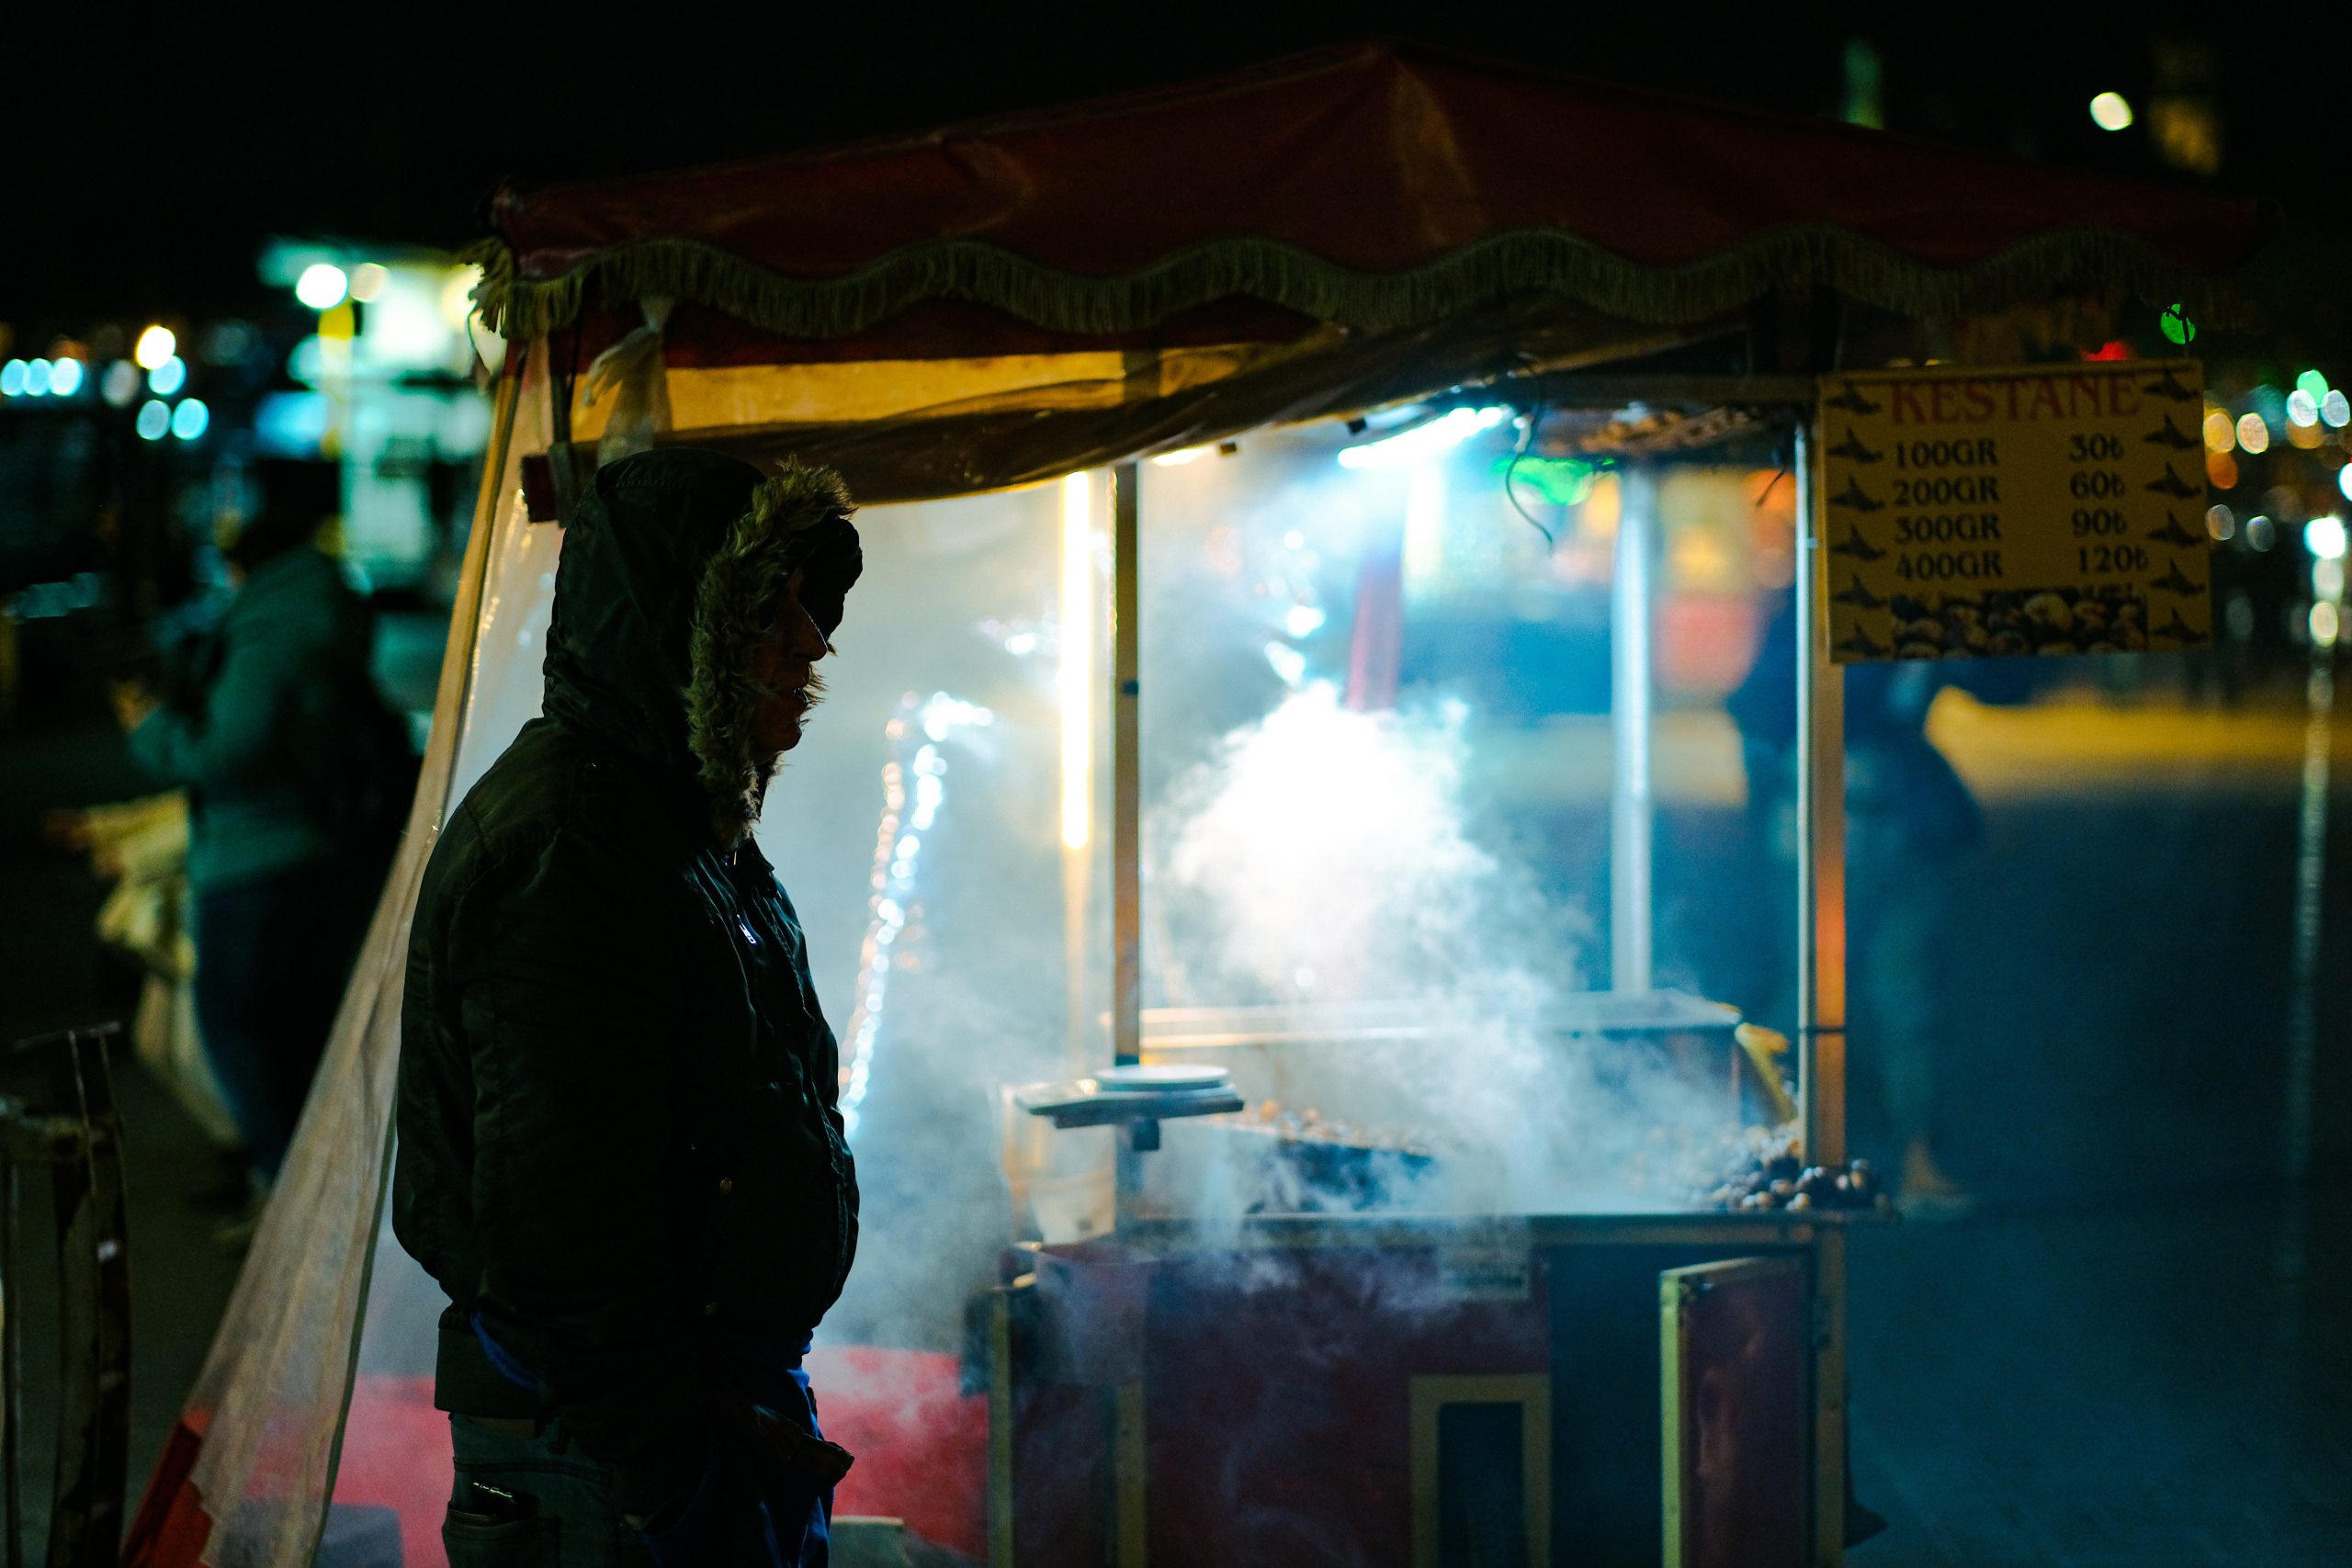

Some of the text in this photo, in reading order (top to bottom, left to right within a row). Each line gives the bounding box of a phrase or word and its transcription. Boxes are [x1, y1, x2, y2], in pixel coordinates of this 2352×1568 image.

[1889, 373, 2141, 426] KESTANE
[1895, 436, 1999, 470] 100GR
[1892, 474, 2001, 507] 200GR
[1894, 512, 2002, 545] 300GR
[1895, 549, 2004, 581] 400GR
